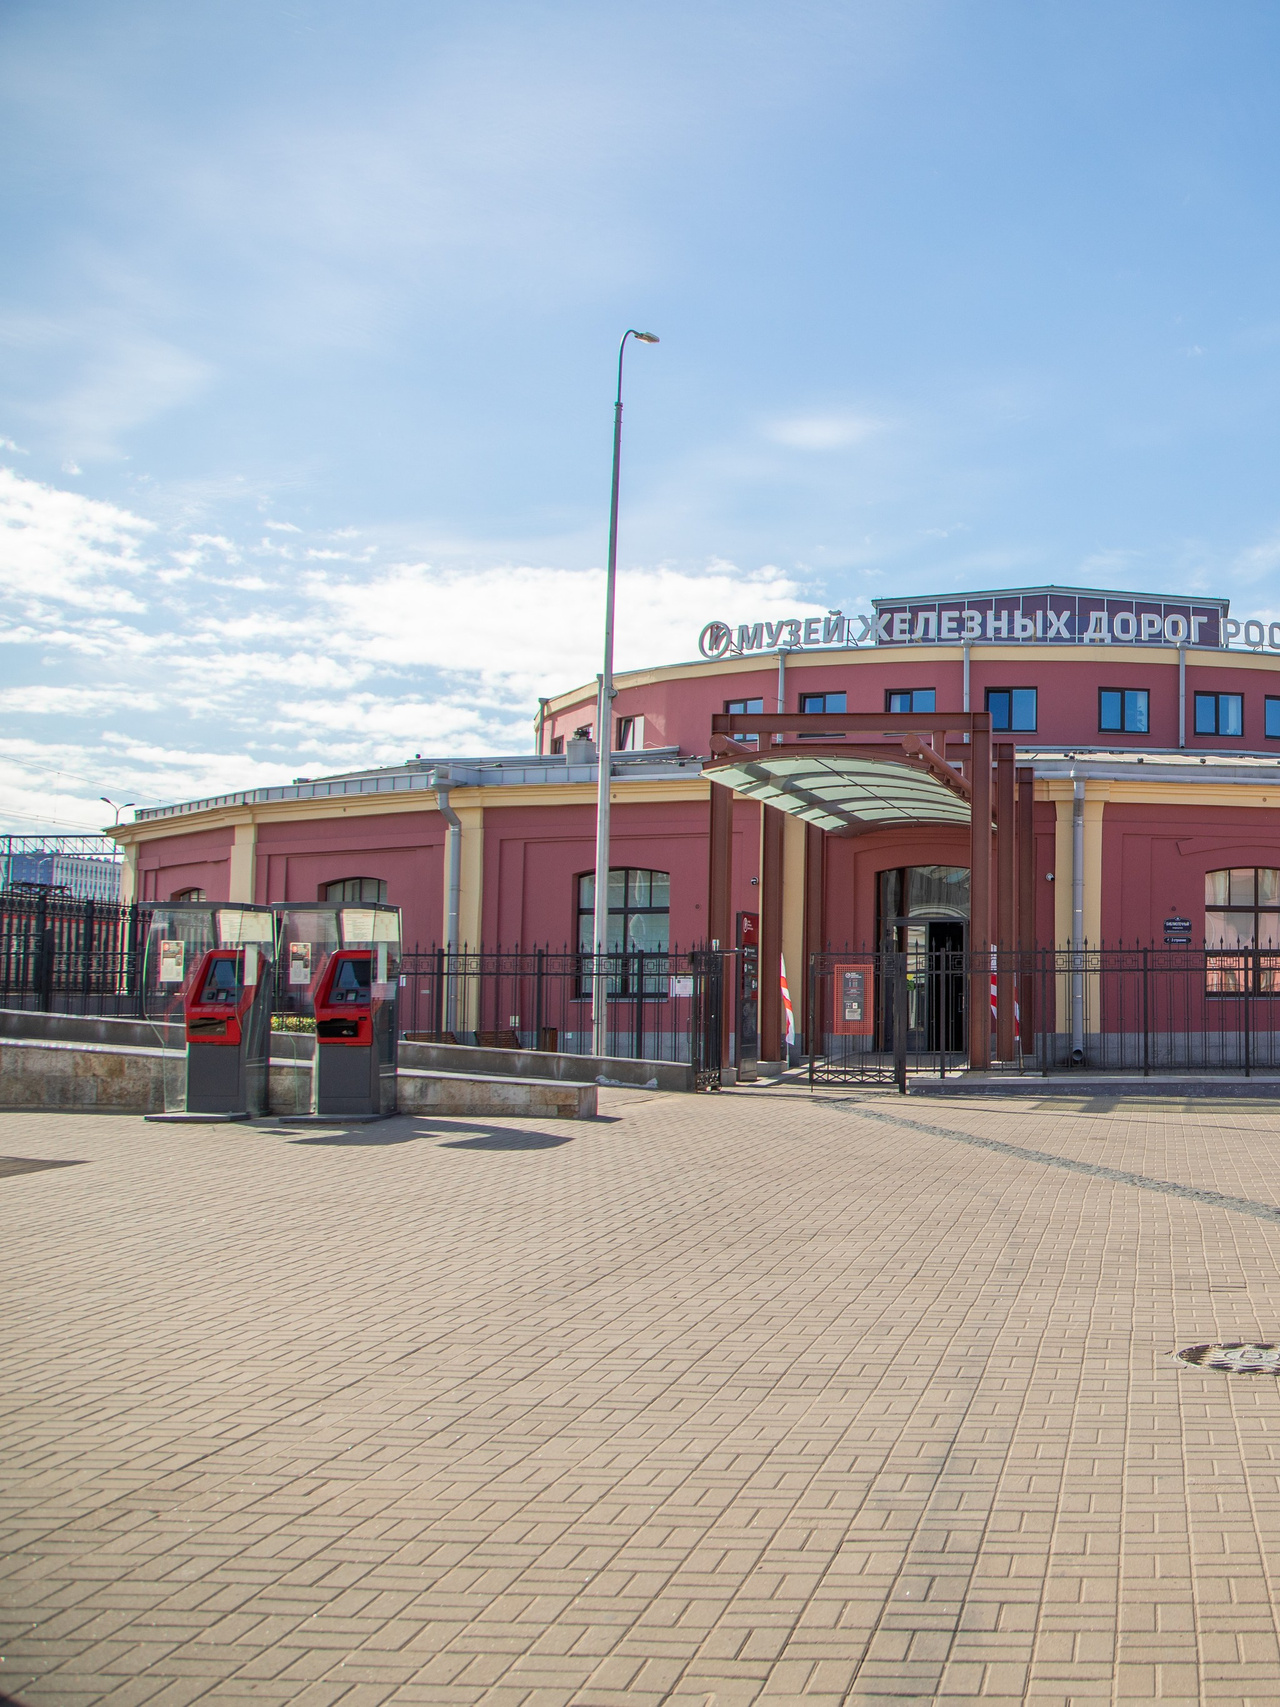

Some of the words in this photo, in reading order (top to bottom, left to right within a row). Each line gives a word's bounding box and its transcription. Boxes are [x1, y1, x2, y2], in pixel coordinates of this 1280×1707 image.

[737, 609, 845, 651] МУЗЕЙ
[857, 610, 1071, 642] ЖЕЛЕЗНЫХ
[1084, 611, 1208, 643] ДОРОГ
